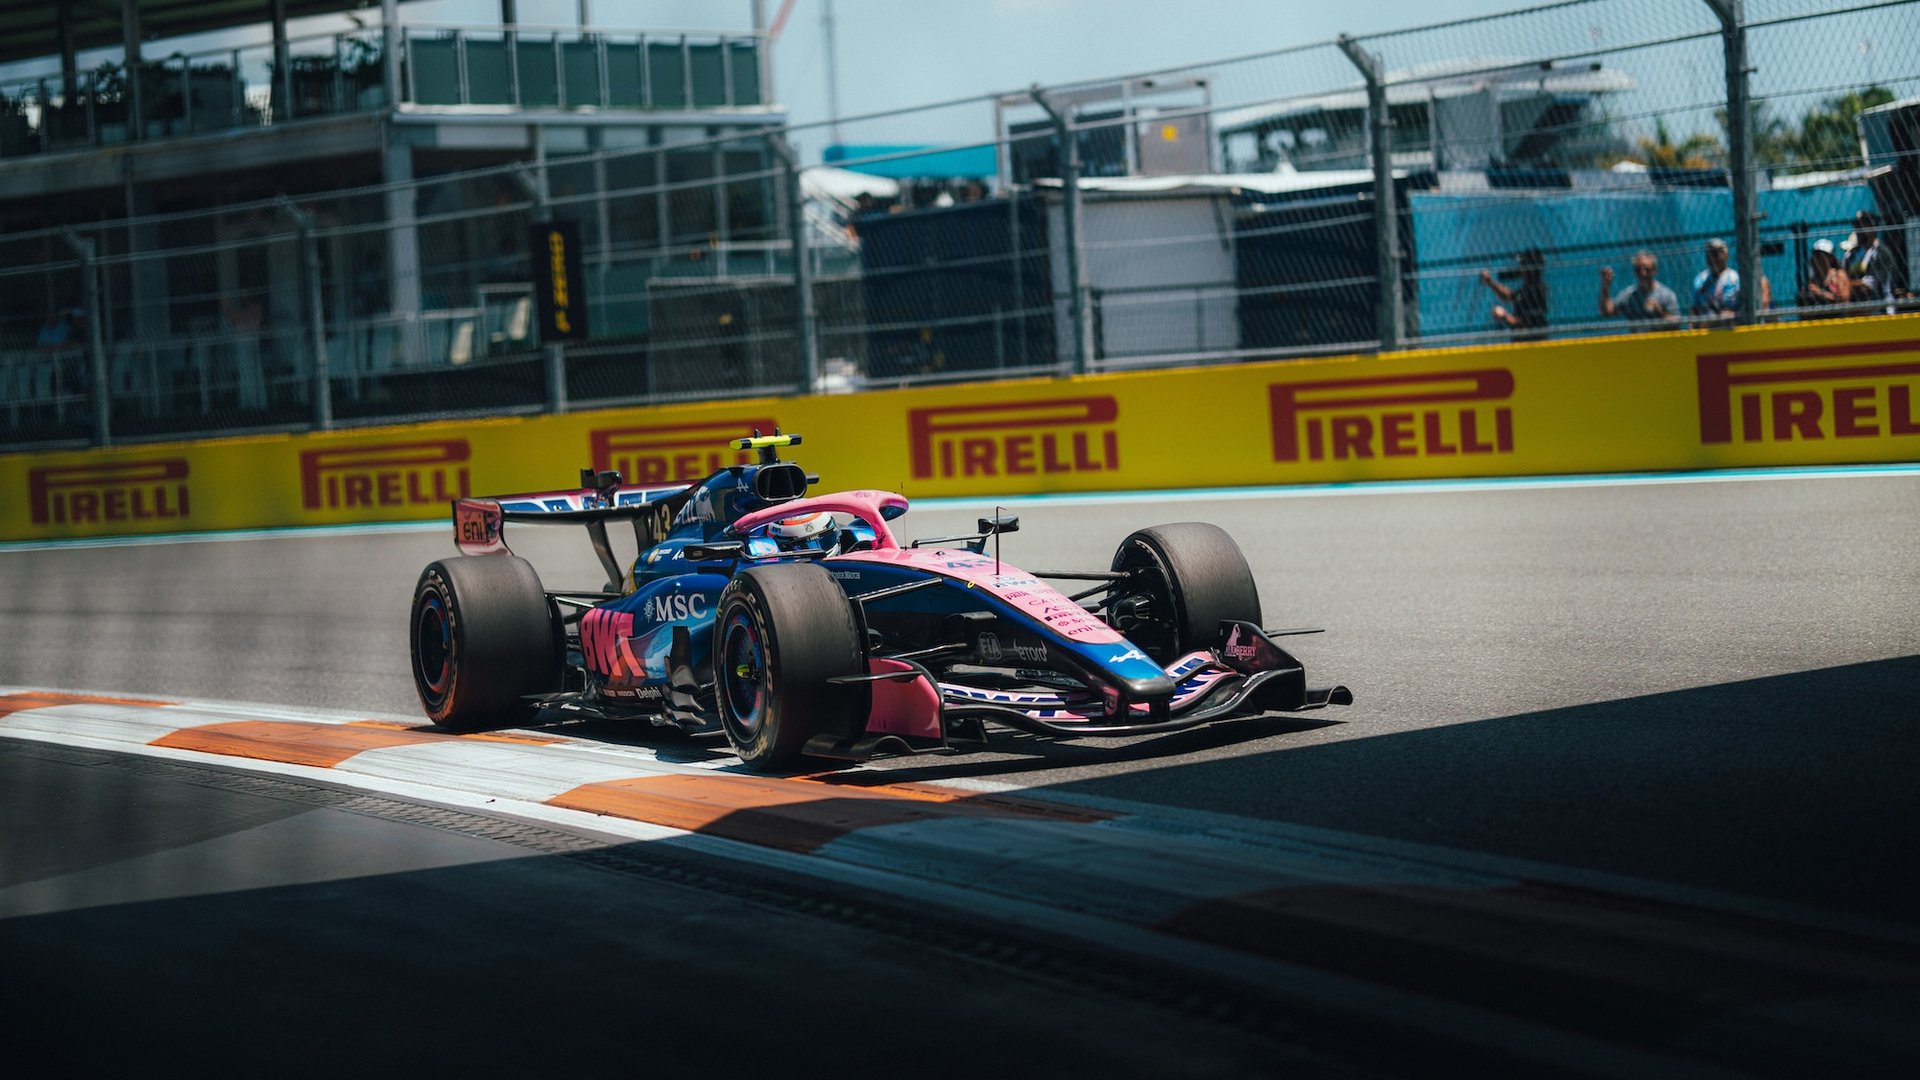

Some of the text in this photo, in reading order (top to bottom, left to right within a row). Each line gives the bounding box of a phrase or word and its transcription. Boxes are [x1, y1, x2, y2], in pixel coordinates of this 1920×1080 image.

[908, 394, 1119, 478] PIRELLI
[1269, 368, 1515, 462] PIRELLI
[301, 438, 472, 510] PIRELLI
[590, 417, 779, 484] PIREL
[29, 457, 190, 525] PIRELLI
[653, 503, 671, 542] 43
[462, 513, 484, 541] eni
[655, 593, 707, 622] MSC
[581, 608, 646, 677] BWT
[980, 637, 1000, 656] FIA
[635, 686, 663, 700] Delphi
